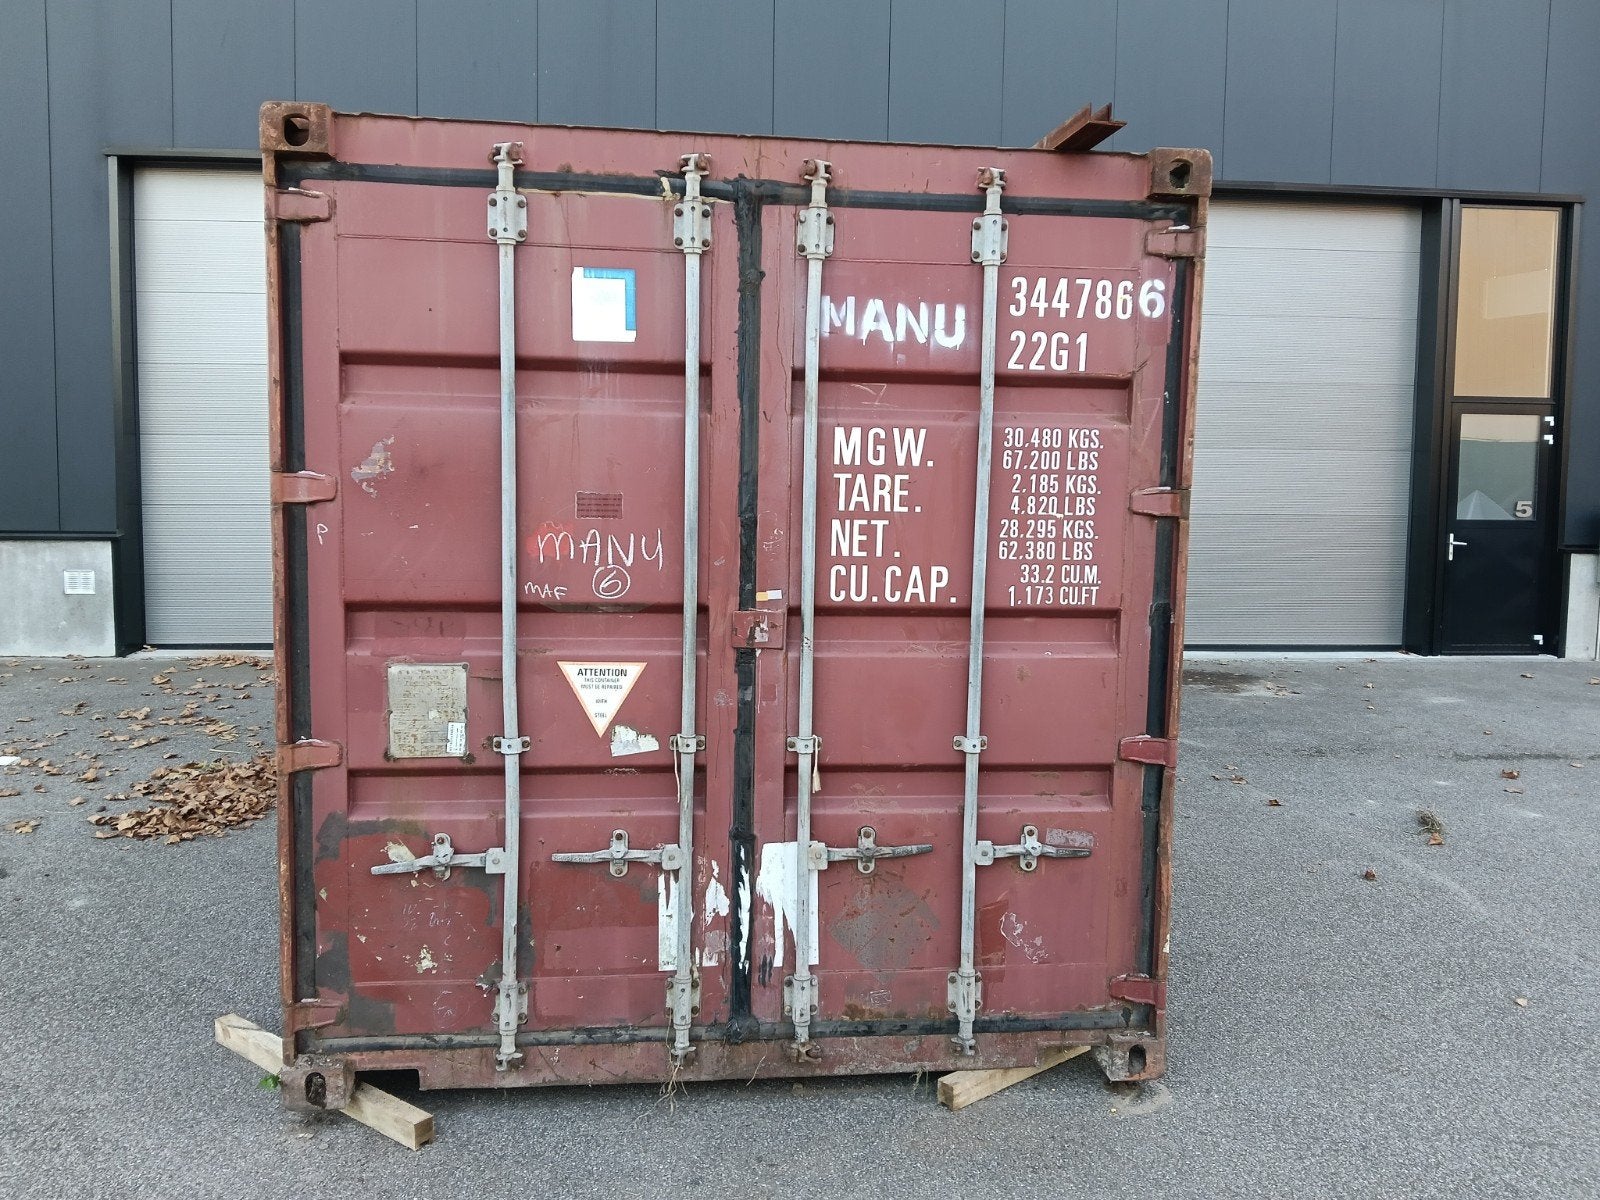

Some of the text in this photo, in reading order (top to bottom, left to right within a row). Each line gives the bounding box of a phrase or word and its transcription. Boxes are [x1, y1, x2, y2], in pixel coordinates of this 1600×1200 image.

[1009, 276, 1166, 320] 3447866
[820, 295, 967, 350] MANU
[1007, 330, 1089, 372] 22G1
[1004, 427, 1104, 449] 30,480 KGS.
[1002, 449, 1099, 471] 67,200 LBS
[833, 473, 922, 513] TARE.
[1011, 473, 1102, 495] 2,185 KGS.
[1010, 495, 1096, 516] 4,820 LBS
[1515, 500, 1533, 518] 5
[830, 518, 901, 558] NET.
[999, 519, 1099, 540] 28,295 KGS.
[998, 540, 1093, 561] 62,380 LBS
[829, 564, 957, 603] CU.CAP.
[1020, 564, 1102, 584] 33.2 CU.M.
[1008, 585, 1099, 607] 1,173 CU.FT
[577, 668, 628, 677] ATTENTION
